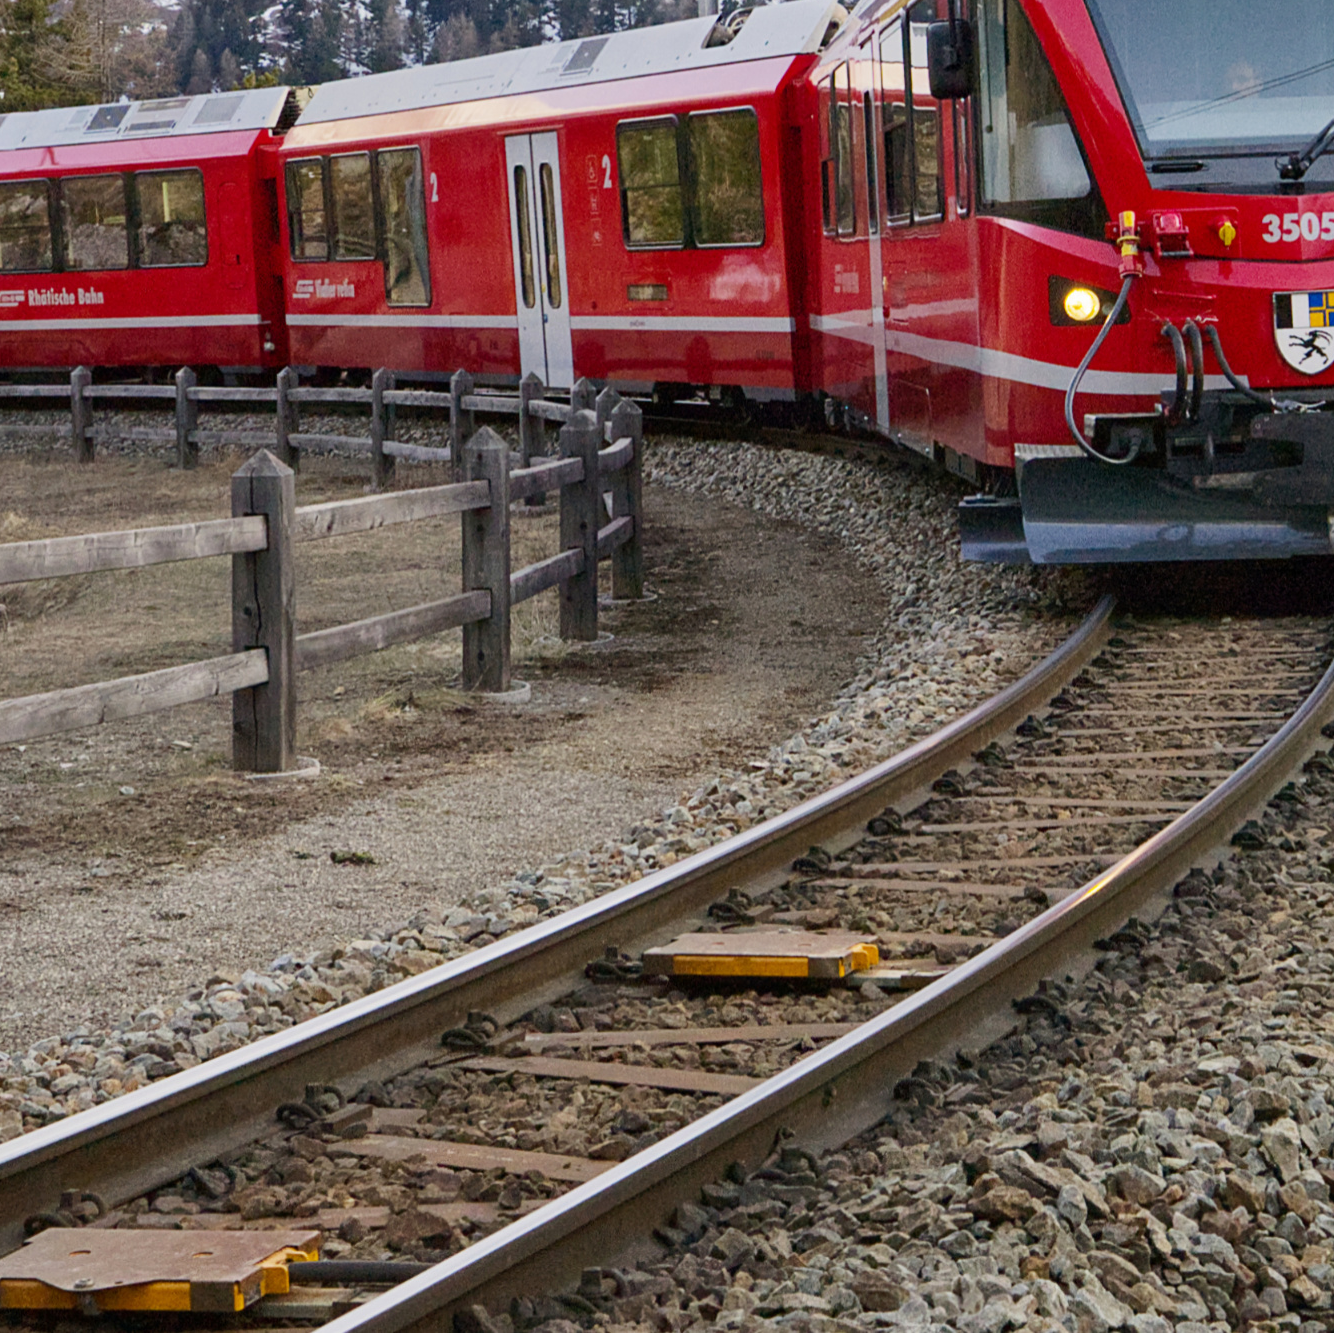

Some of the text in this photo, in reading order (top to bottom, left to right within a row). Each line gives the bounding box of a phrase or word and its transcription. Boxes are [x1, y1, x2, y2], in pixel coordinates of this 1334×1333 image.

[430, 171, 439, 203] 2
[601, 154, 613, 189] 2
[27, 287, 76, 306] Rhätische
[77, 286, 105, 305] Bahn
